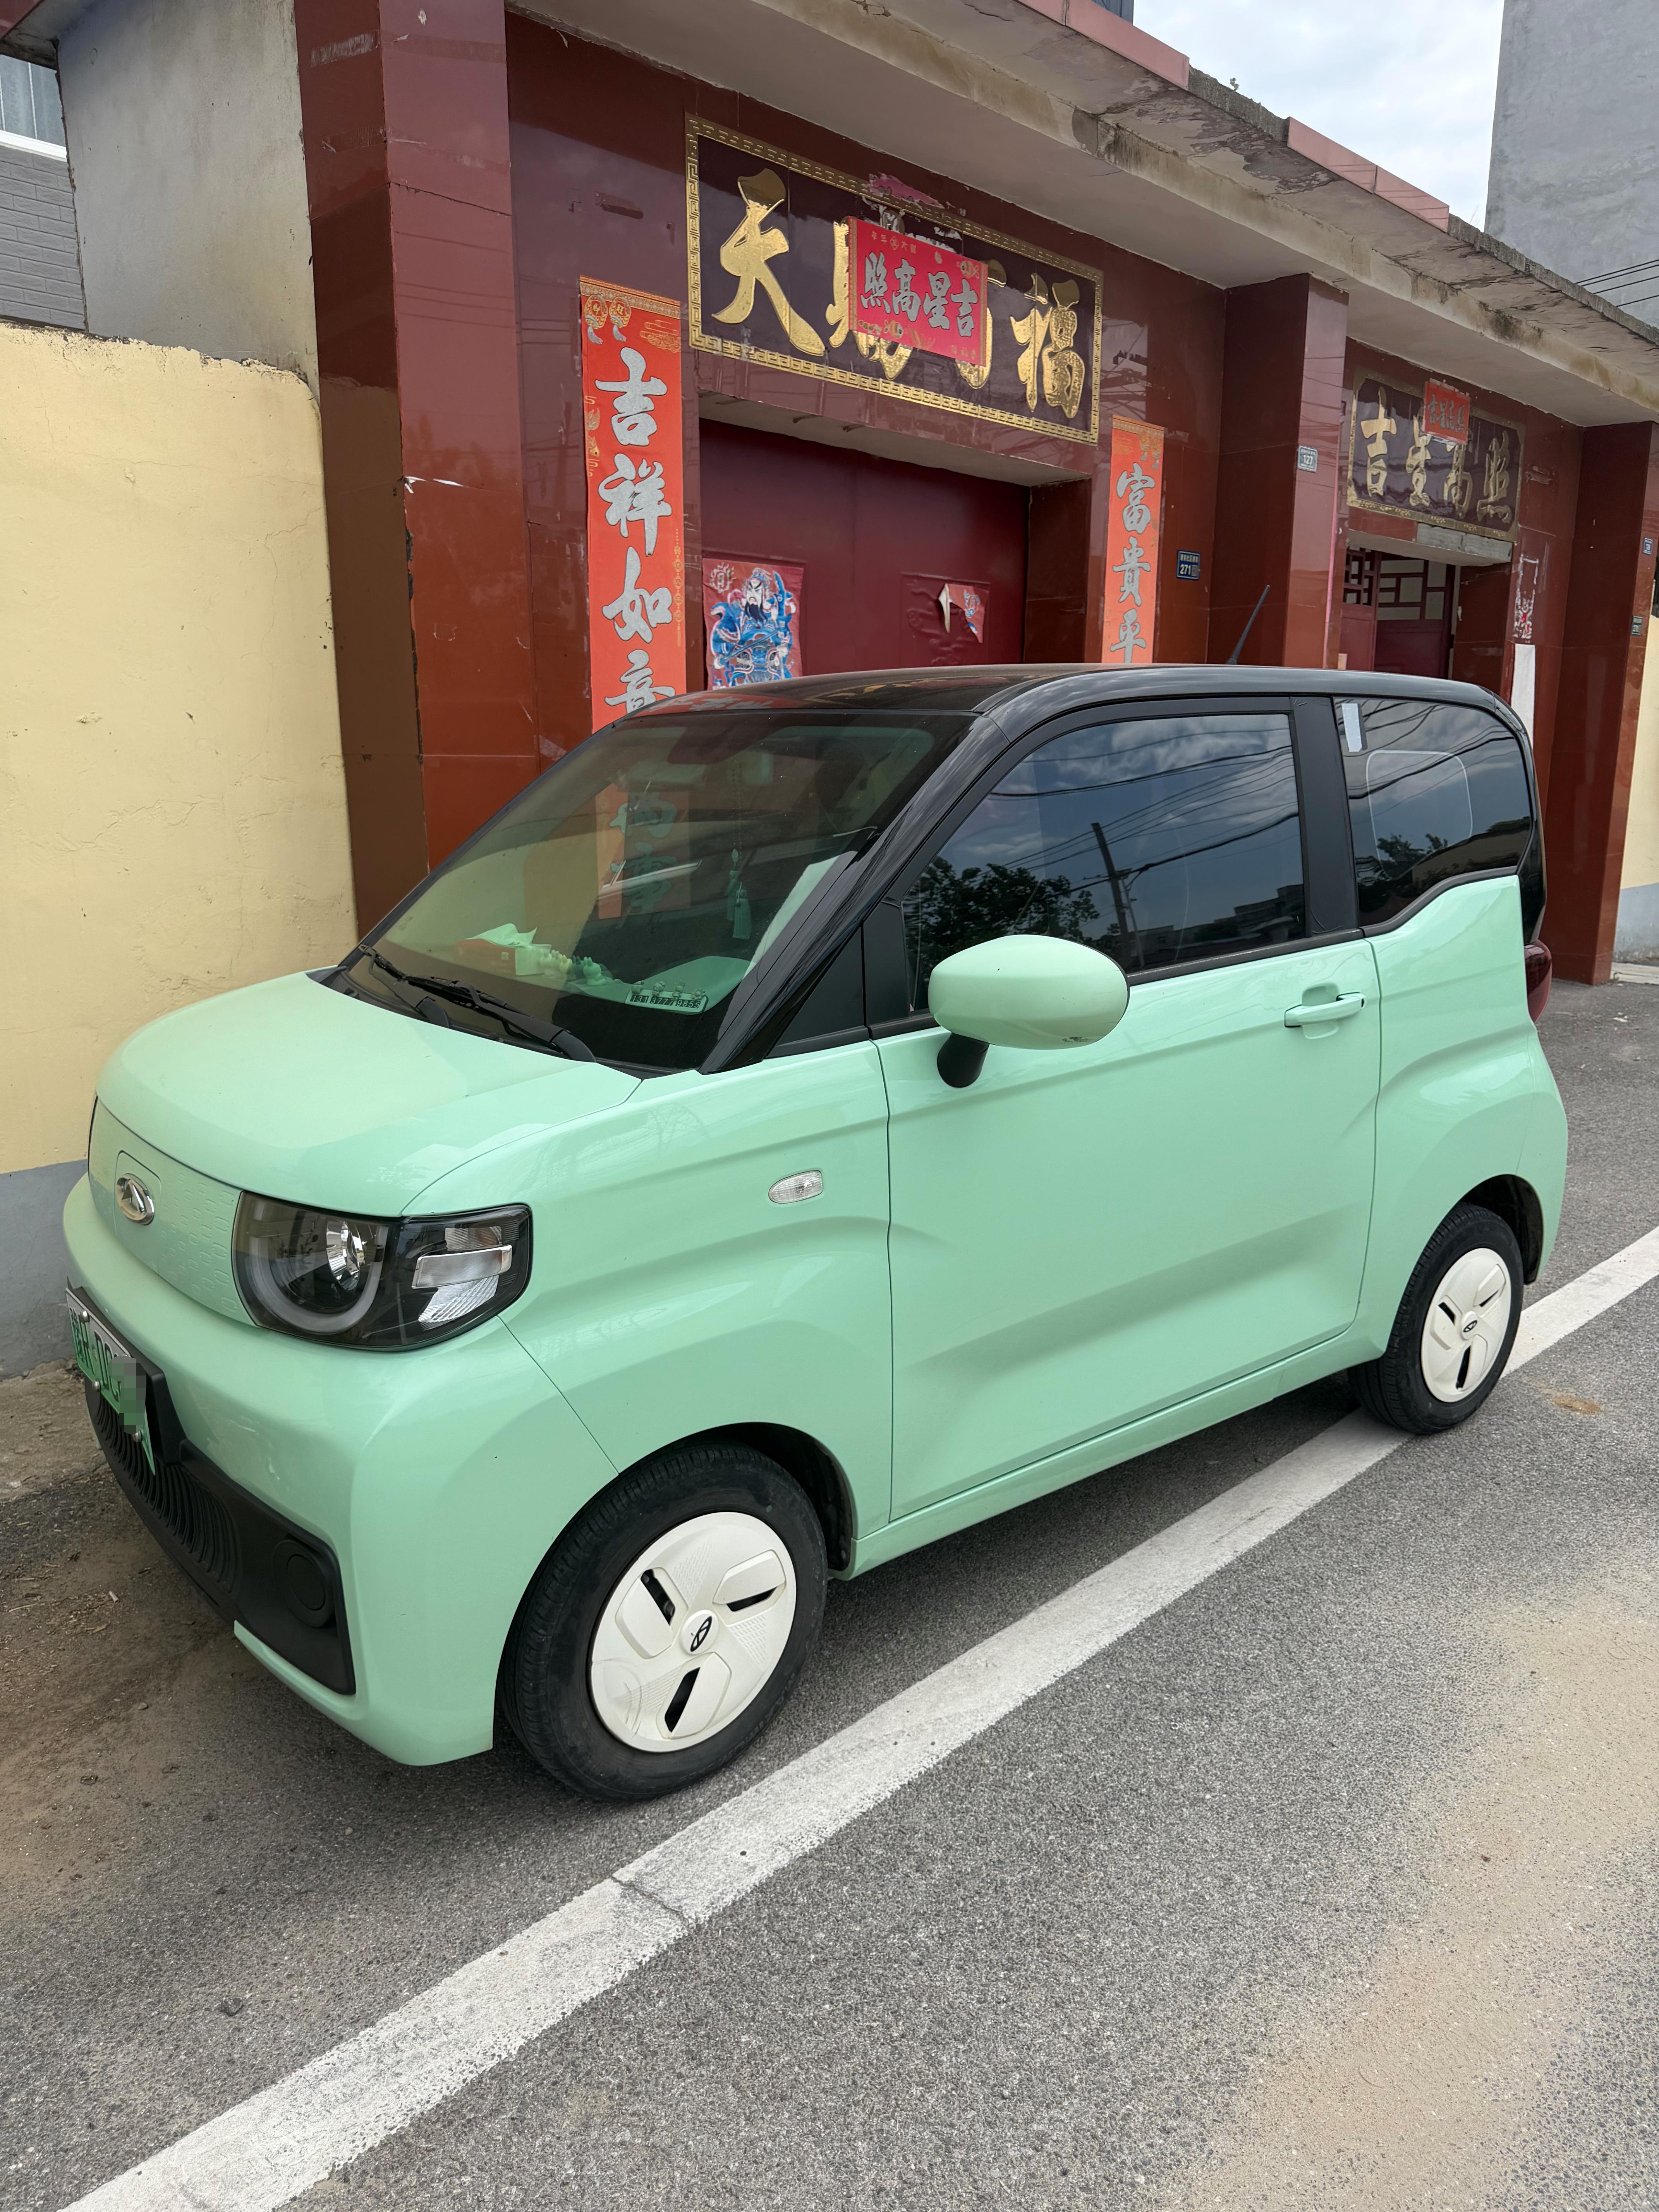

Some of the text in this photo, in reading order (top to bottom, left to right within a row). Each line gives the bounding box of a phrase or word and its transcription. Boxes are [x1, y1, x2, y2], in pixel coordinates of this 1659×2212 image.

[1304, 455, 1313, 465] 127
[1180, 564, 1191, 575] 271
[651, 997, 674, 1005] 3777
[677, 1000, 700, 1008] 9855
